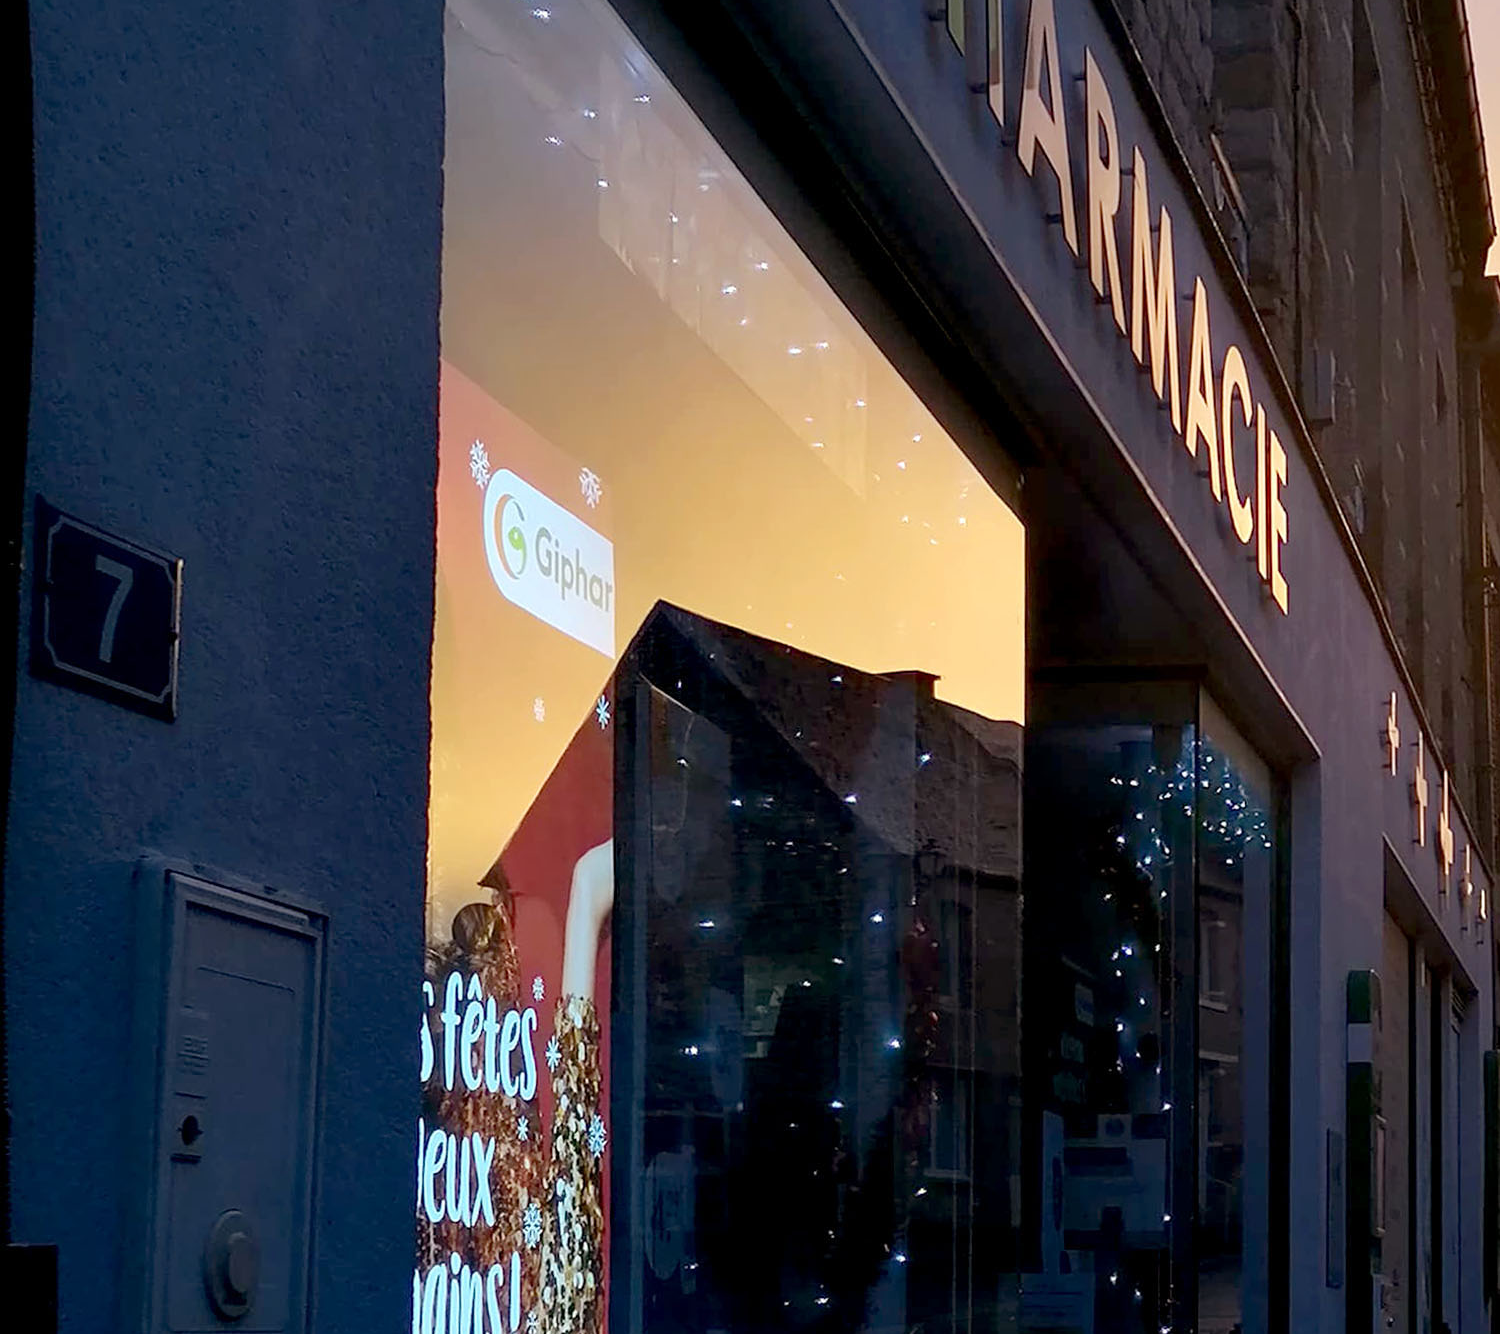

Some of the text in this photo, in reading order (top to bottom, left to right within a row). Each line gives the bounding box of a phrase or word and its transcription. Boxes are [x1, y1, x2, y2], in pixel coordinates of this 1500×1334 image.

[95, 554, 134, 663] 7
[535, 527, 613, 613] Giphar
[440, 971, 537, 1101] fêtes
